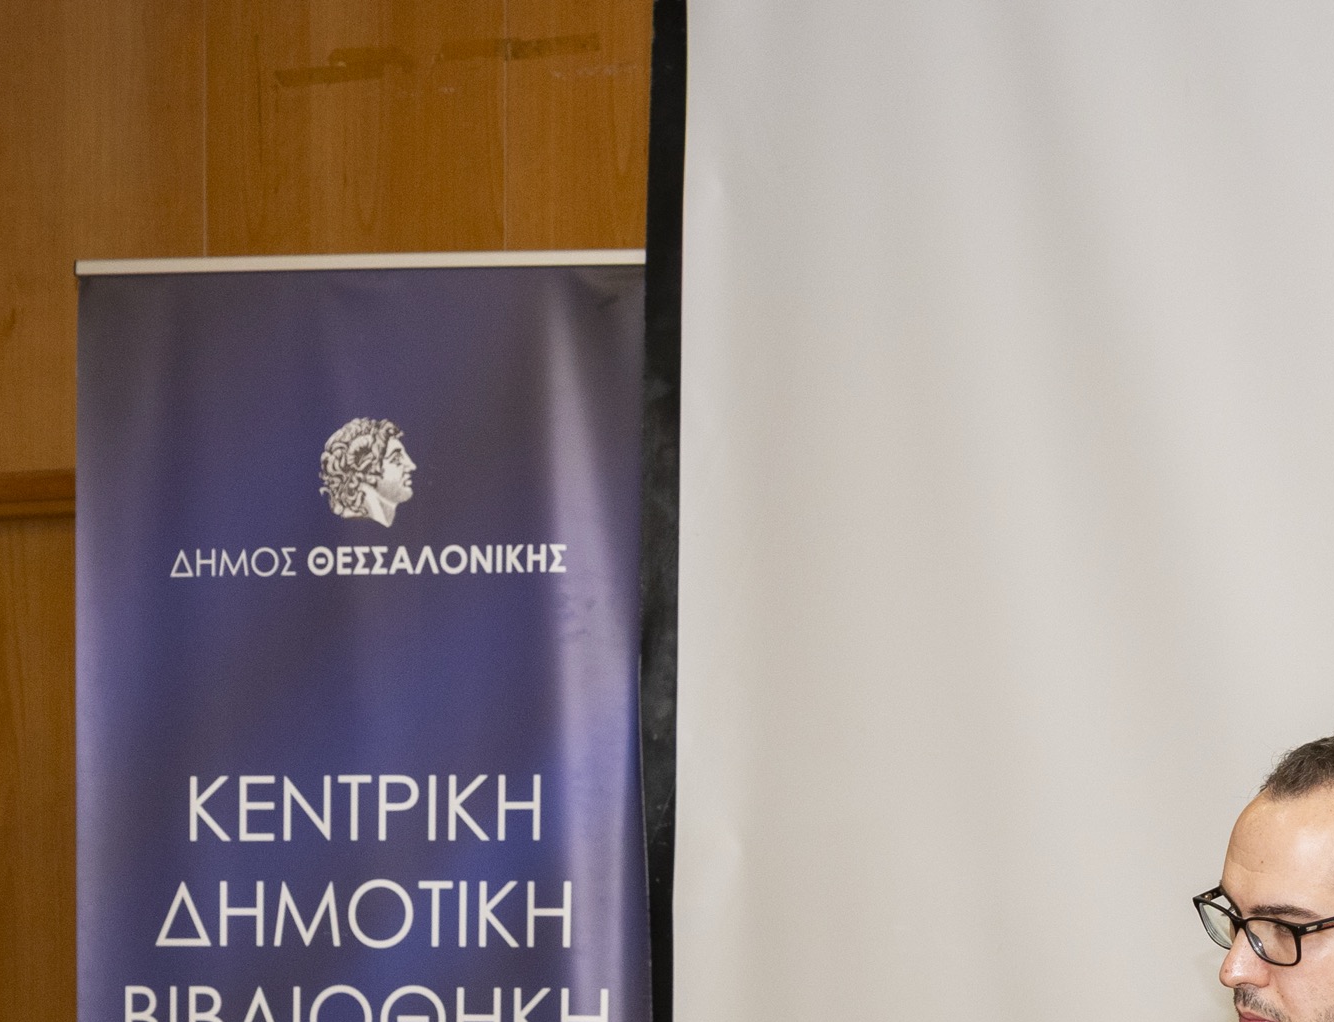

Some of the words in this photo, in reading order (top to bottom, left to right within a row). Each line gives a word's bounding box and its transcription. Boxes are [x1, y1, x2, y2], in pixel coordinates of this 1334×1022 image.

[170, 546, 297, 578] ΔΗΜΟΣ
[307, 543, 568, 576] ΘΕΣΣΑΛΟΝΙΚΗΣ
[188, 773, 542, 842] ΚΕΝΤΡΙΚΗ
[154, 878, 573, 949] ΔΗΜΟΤΙΚΗ
